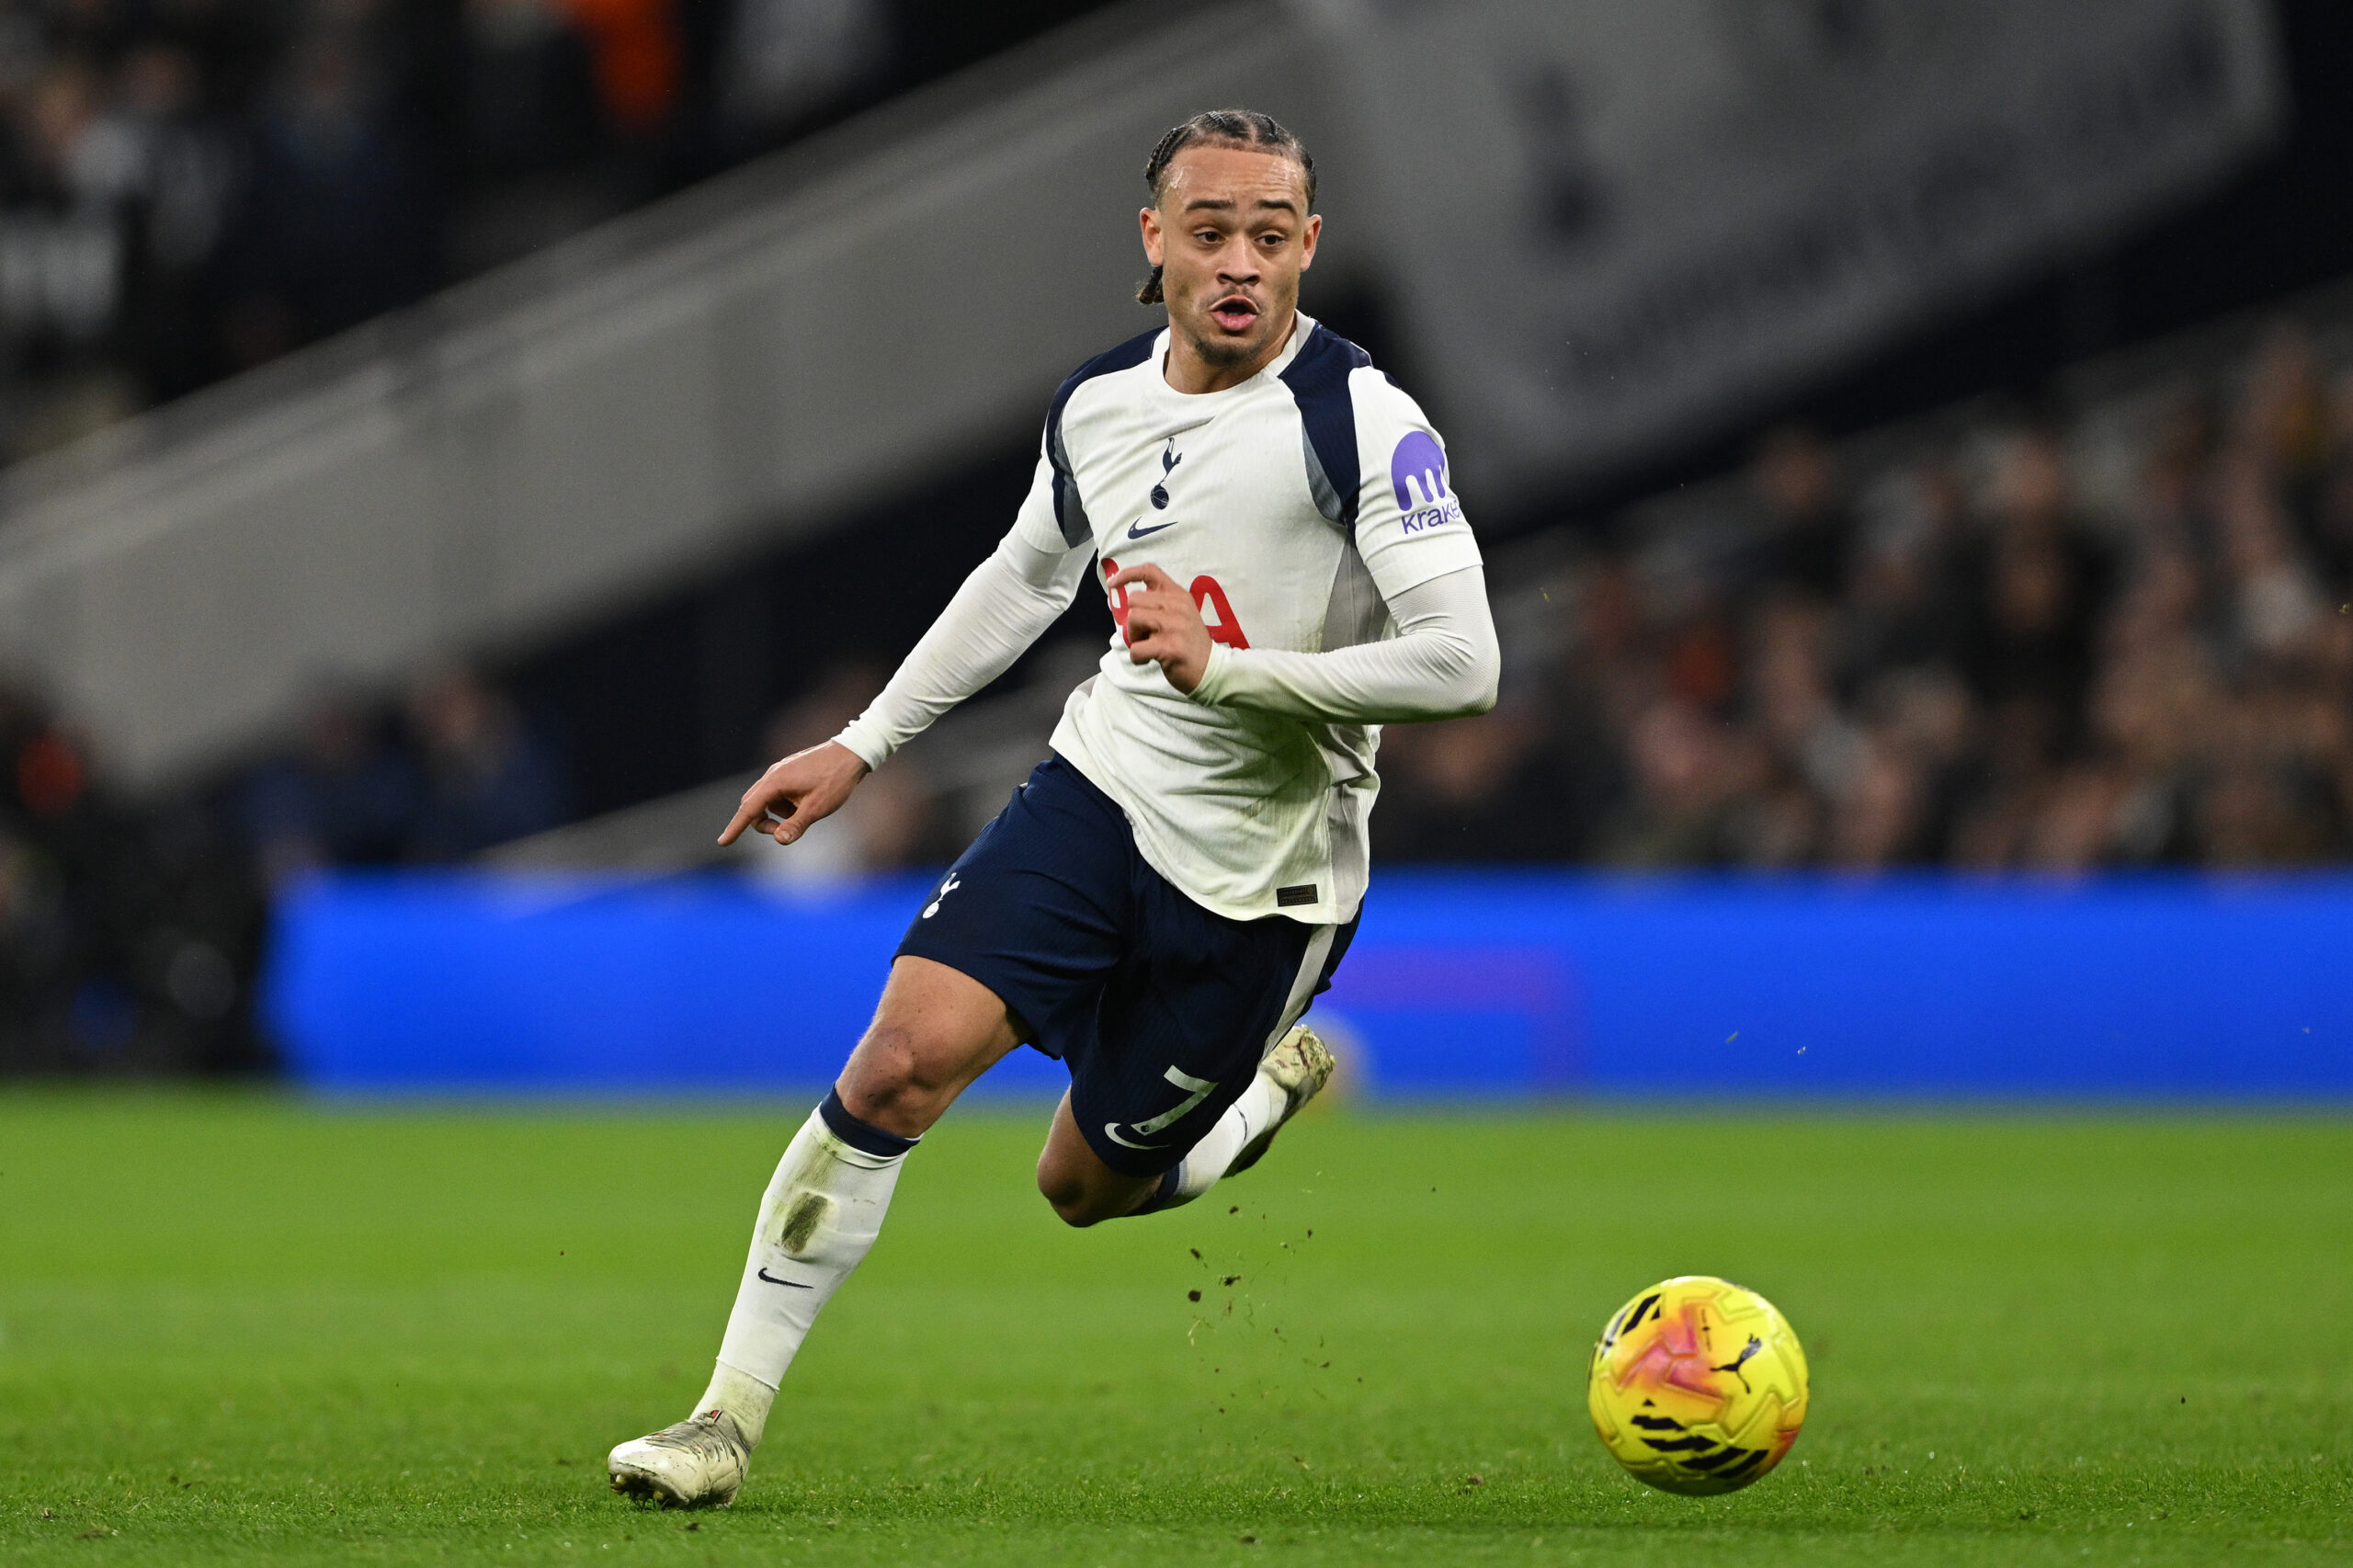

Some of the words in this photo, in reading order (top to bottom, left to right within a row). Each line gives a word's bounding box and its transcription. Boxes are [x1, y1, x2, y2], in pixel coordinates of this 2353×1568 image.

[1401, 499, 1461, 534] krake
[1101, 557, 1251, 650] AA
[1131, 1064, 1219, 1136] 7
